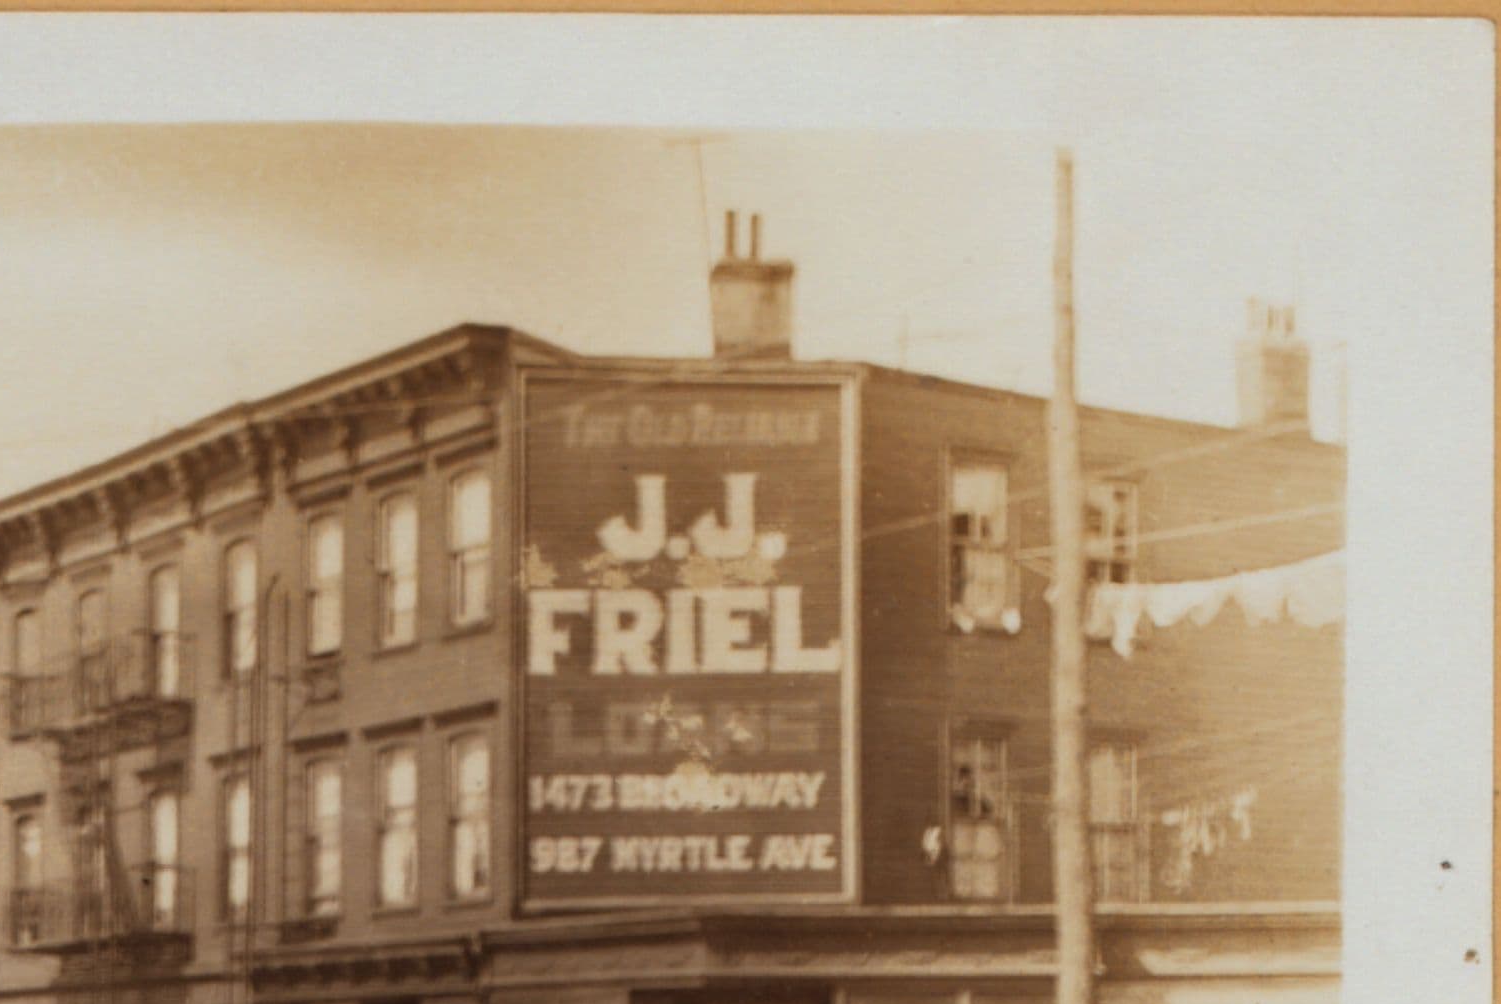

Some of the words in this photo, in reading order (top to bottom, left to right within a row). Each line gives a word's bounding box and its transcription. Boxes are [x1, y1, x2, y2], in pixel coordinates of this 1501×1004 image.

[528, 585, 841, 676] FRIEL
[529, 773, 614, 812] 1473
[610, 835, 753, 872] MYRTLE
